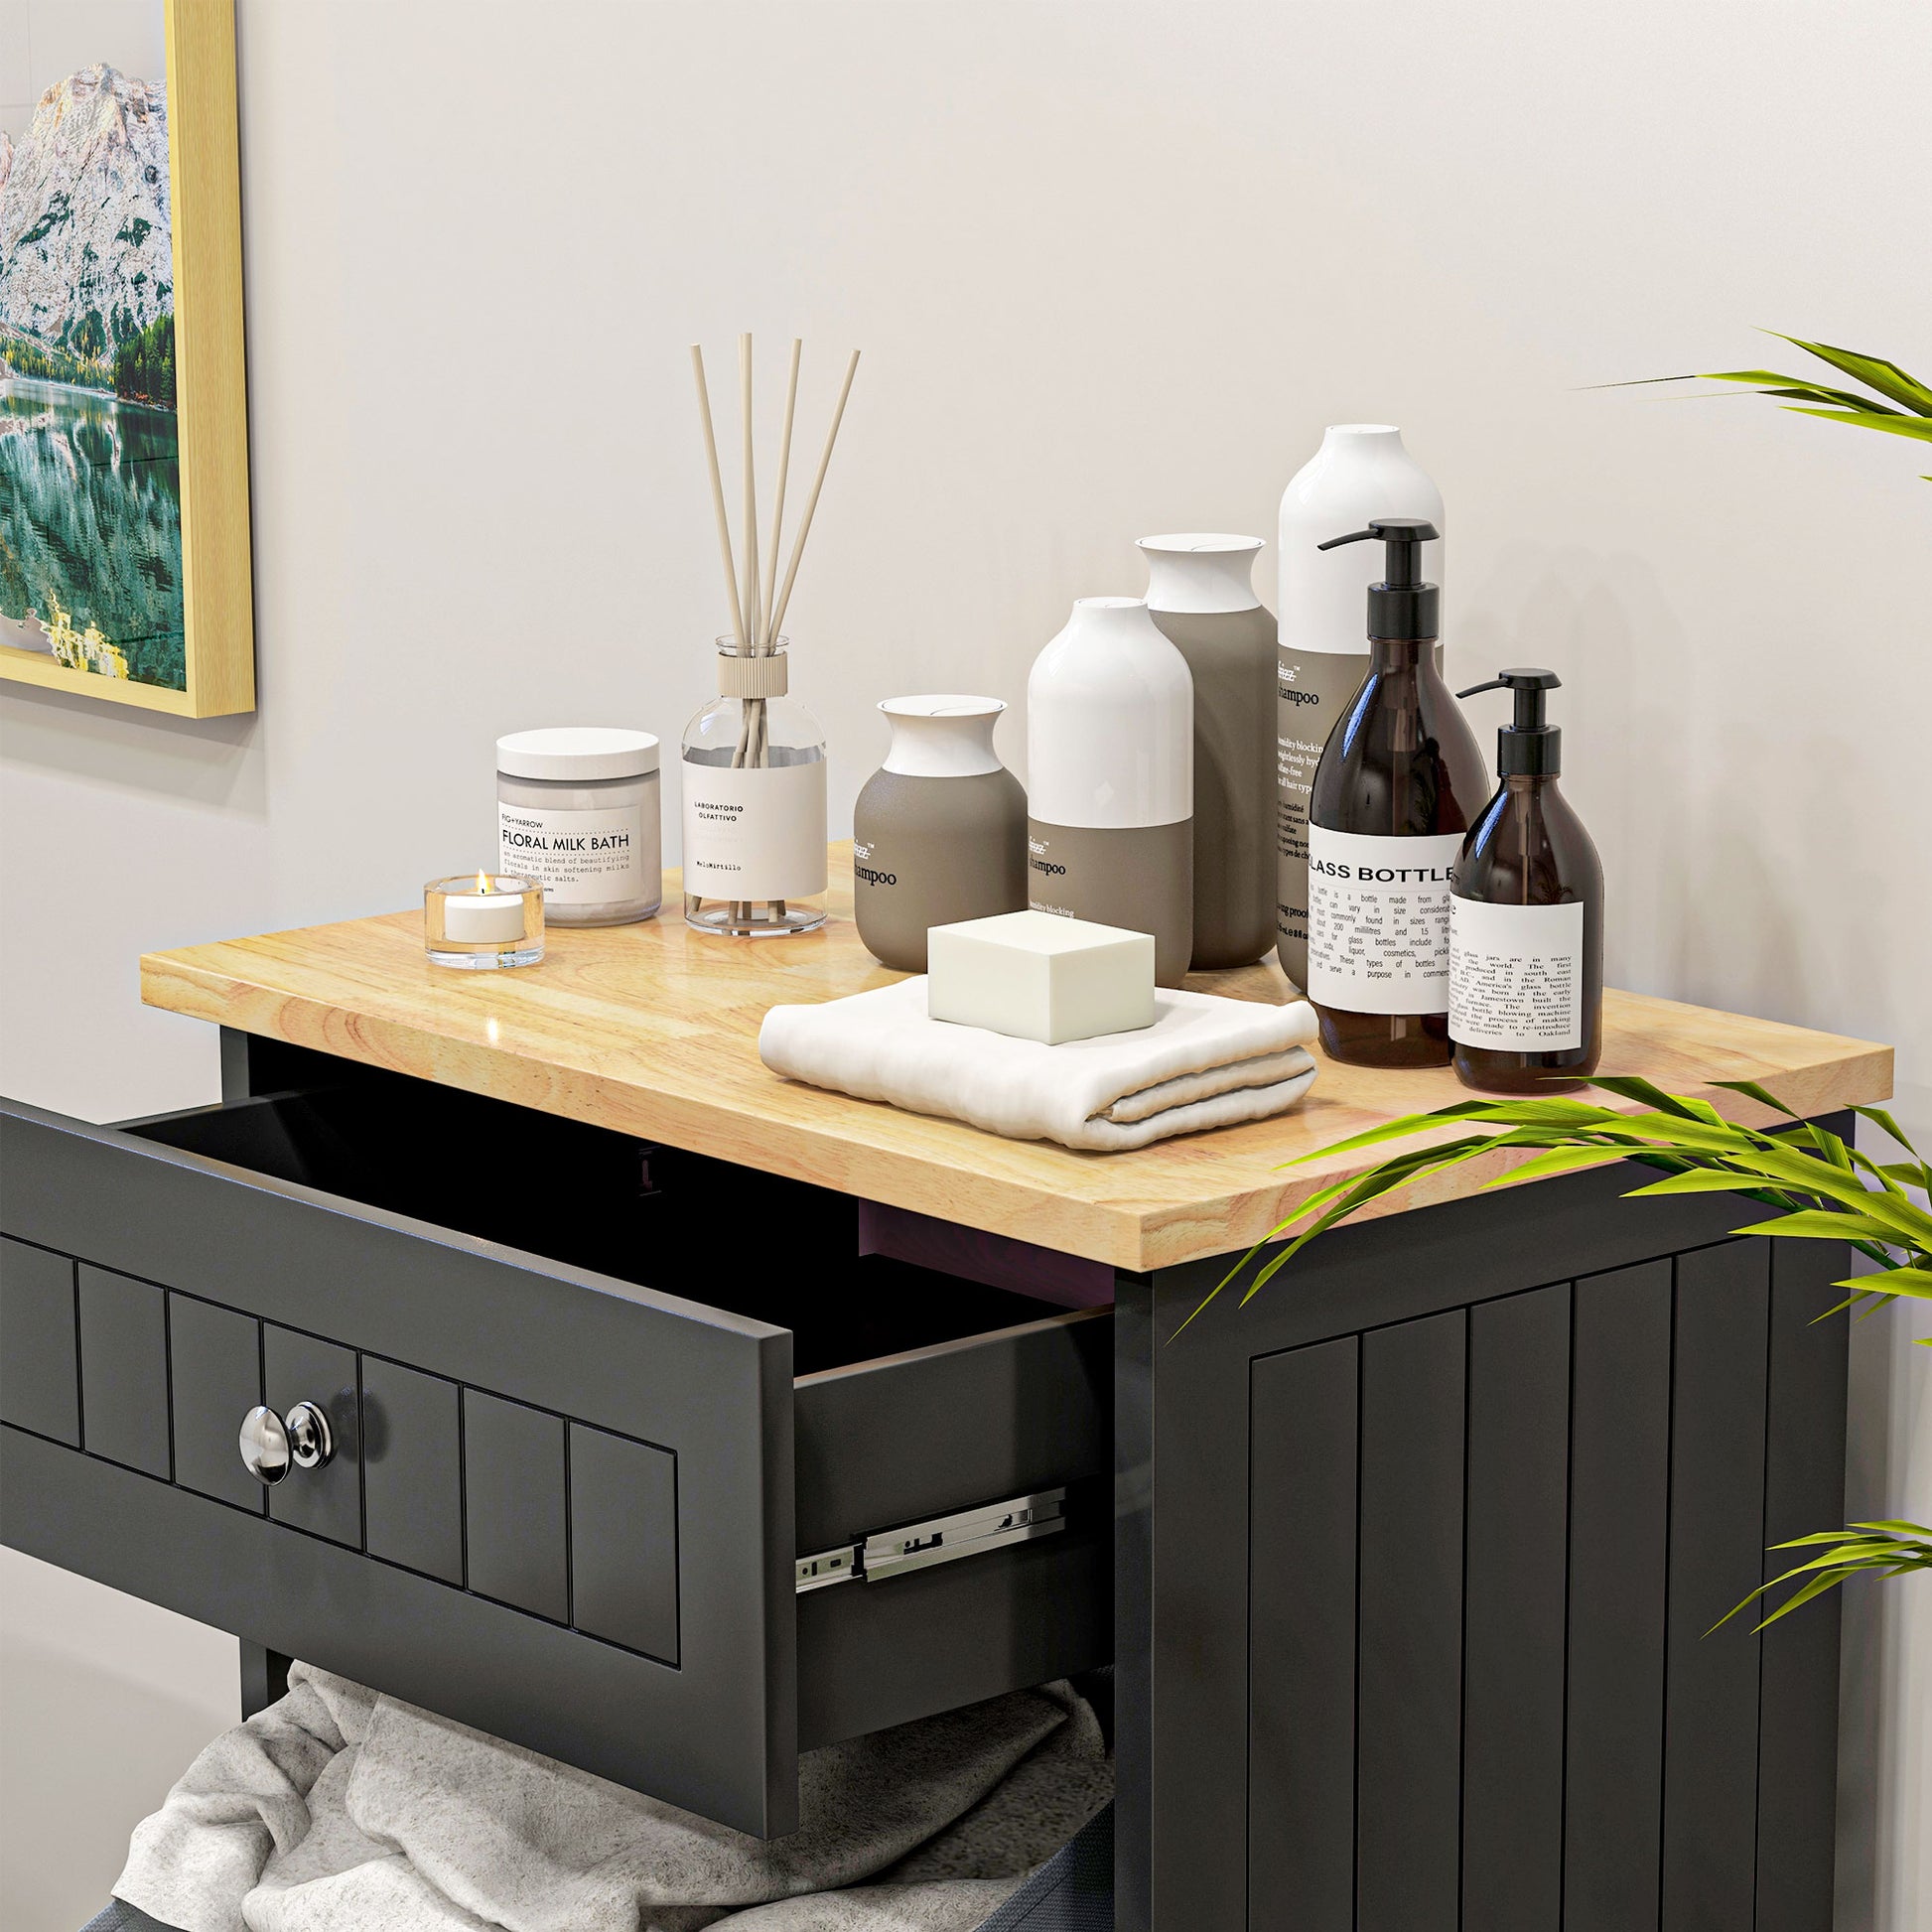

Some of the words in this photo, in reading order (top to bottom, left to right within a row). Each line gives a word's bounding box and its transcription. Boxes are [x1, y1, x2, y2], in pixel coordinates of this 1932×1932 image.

[1297, 741, 1323, 753] blockin
[694, 801, 744, 812] LABORATORIO
[501, 813, 544, 829] FIG+YARROW
[699, 812, 737, 822] OLFATTIVO
[502, 830, 549, 850] FLORAL
[553, 838, 586, 851] MILK
[592, 834, 629, 849] BATH
[513, 854, 543, 863] aromatic
[581, 855, 629, 866] beautifying
[504, 860, 528, 870] florals
[564, 865, 602, 874] softening
[607, 863, 629, 872] milks
[1348, 905, 1361, 914] vary
[1366, 916, 1383, 925] found
[1348, 936, 1363, 945] glass
[1384, 949, 1417, 958] cosmetics,
[1339, 955, 1355, 965] These
[1367, 959, 1383, 968] types
[1396, 959, 1403, 968] of
[1368, 970, 1392, 979] purpose
[1465, 965, 1496, 975] produced
[1480, 995, 1525, 1004] Jamestown
[1469, 1027, 1503, 1036] deliveries
